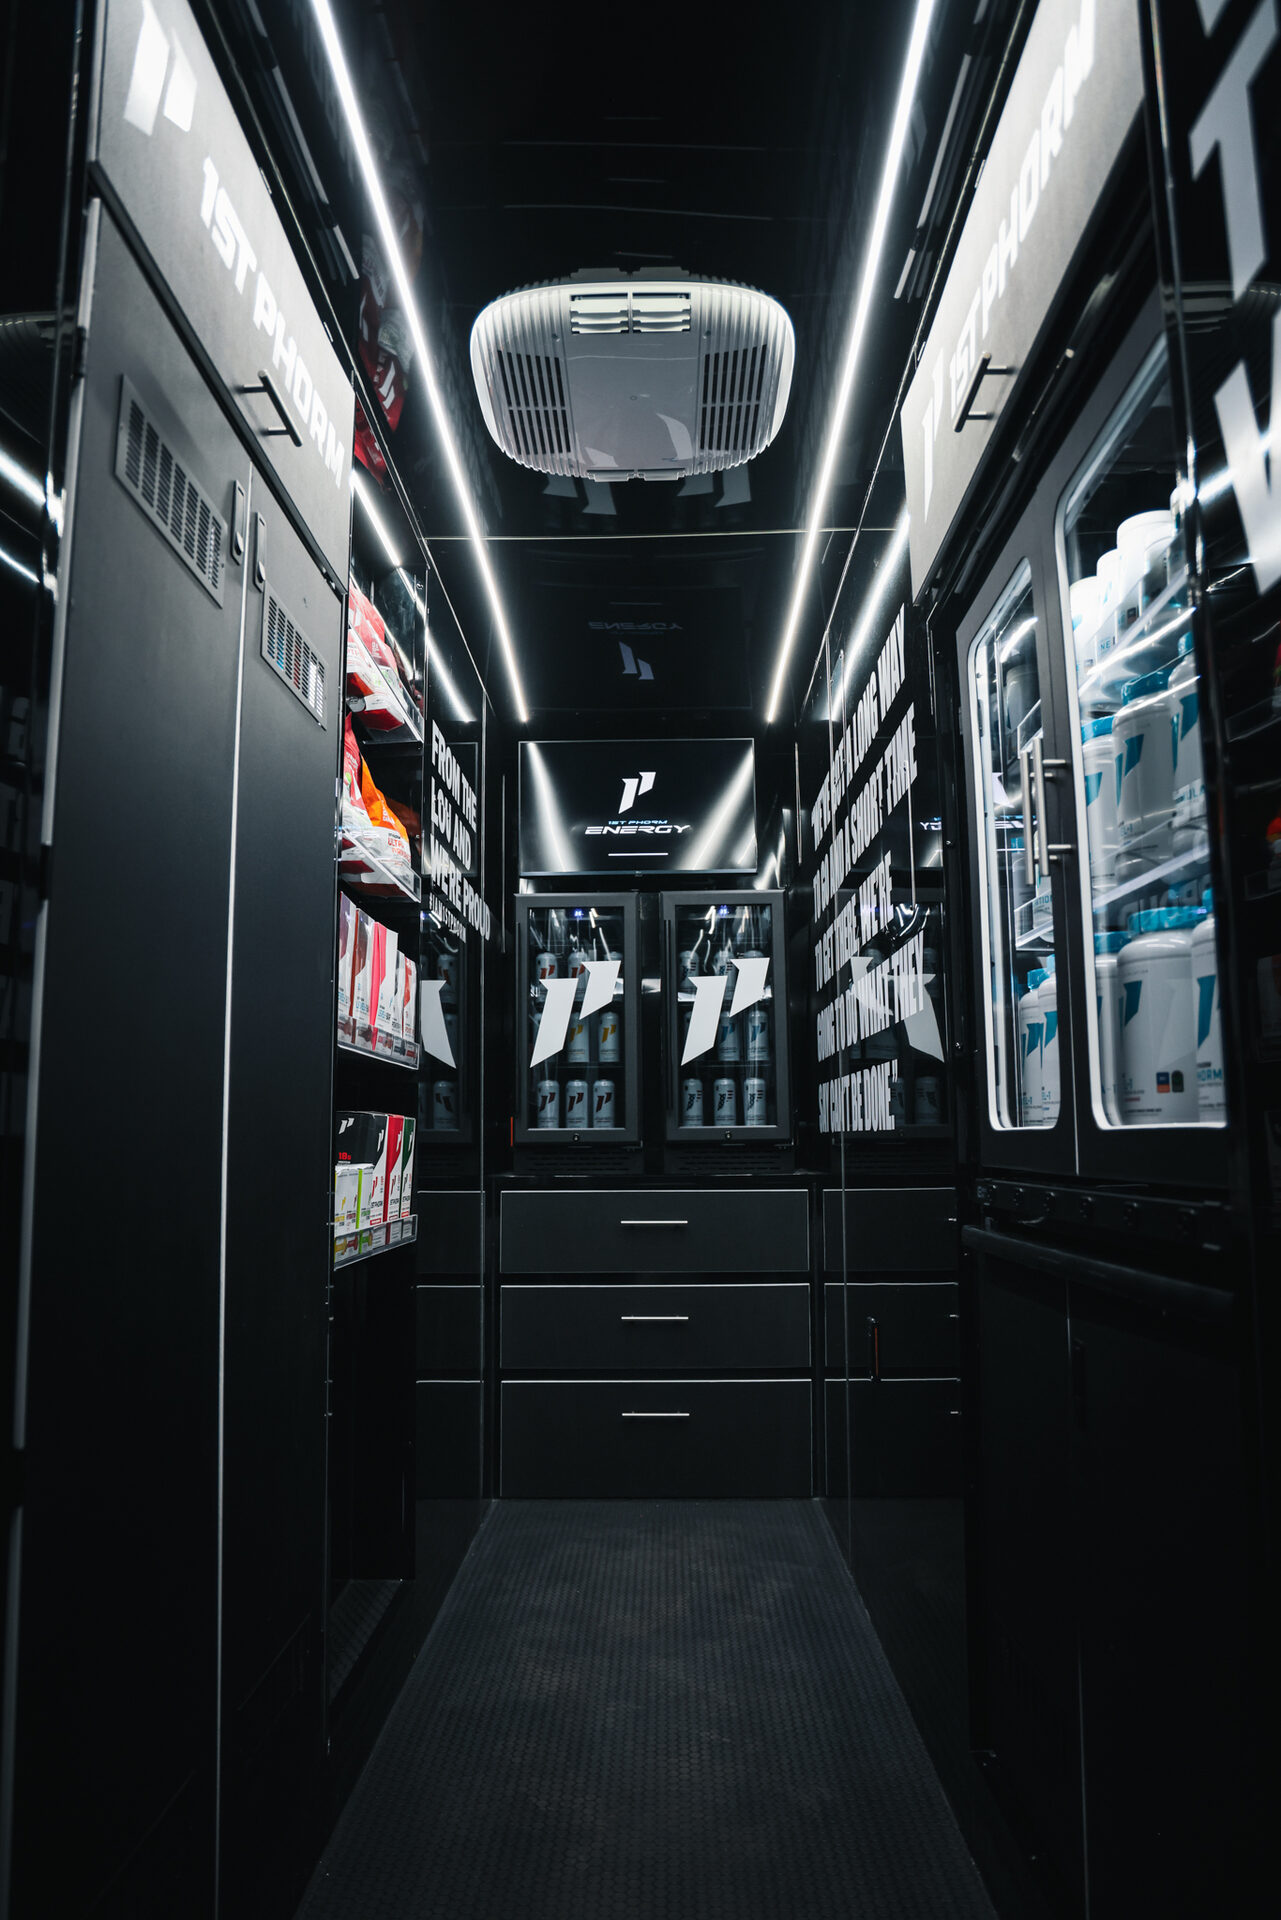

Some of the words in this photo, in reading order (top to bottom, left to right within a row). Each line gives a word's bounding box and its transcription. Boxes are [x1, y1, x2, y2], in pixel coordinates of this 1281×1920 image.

[200, 157, 257, 293] 1ST
[253, 271, 346, 488] PHORM
[846, 725, 853, 787] A
[853, 671, 879, 774] LONG
[878, 603, 906, 721] WAY
[431, 719, 460, 806] FROM
[461, 772, 477, 833] THE
[431, 775, 451, 843] LOU
[452, 813, 472, 871] AND
[584, 824, 691, 835] ENERGY
[813, 869, 821, 923] TO
[829, 829, 844, 899] AND
[845, 817, 851, 877] A
[851, 757, 883, 865] SHORT
[885, 703, 917, 816] TIME
[463, 876, 490, 941] PROUD
[815, 940, 823, 992] TO
[823, 923, 834, 984] GET
[859, 850, 894, 946] WE'RE
[817, 1002, 835, 1062] GOING
[835, 994, 846, 1052] TO
[845, 984, 858, 1047] DO
[857, 958, 890, 1040] WHAT
[891, 929, 924, 1024] THEY
[819, 1082, 829, 1133] SAY
[830, 1075, 850, 1133] CAN'T
[851, 1071, 863, 1131] BE
